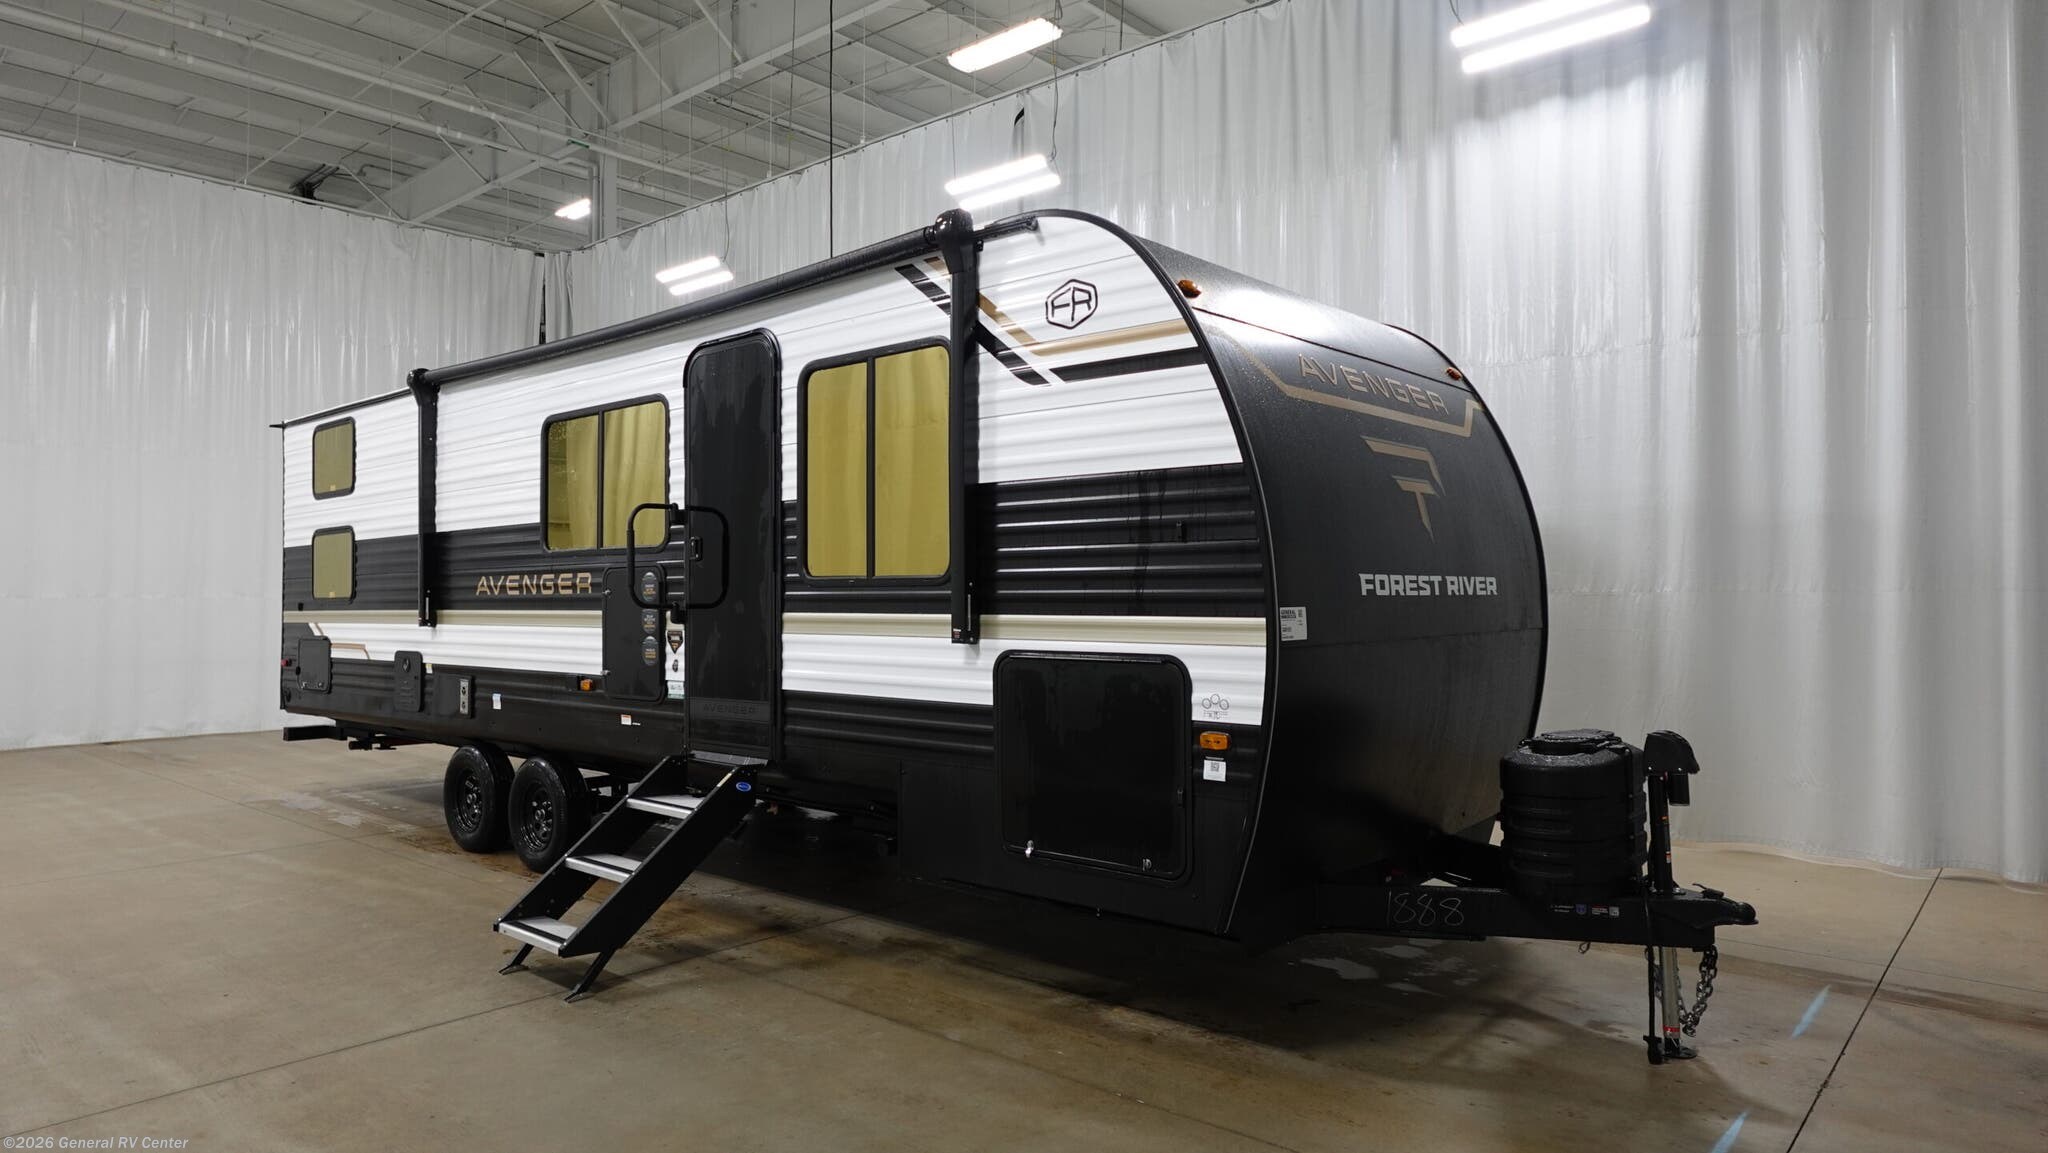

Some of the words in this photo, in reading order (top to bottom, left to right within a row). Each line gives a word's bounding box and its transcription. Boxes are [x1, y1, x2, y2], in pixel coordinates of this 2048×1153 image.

[1299, 353, 1449, 415] AVENGER
[475, 572, 592, 596] AVENGER
[1359, 573, 1442, 596] FOREST
[1445, 575, 1498, 596] RIVER
